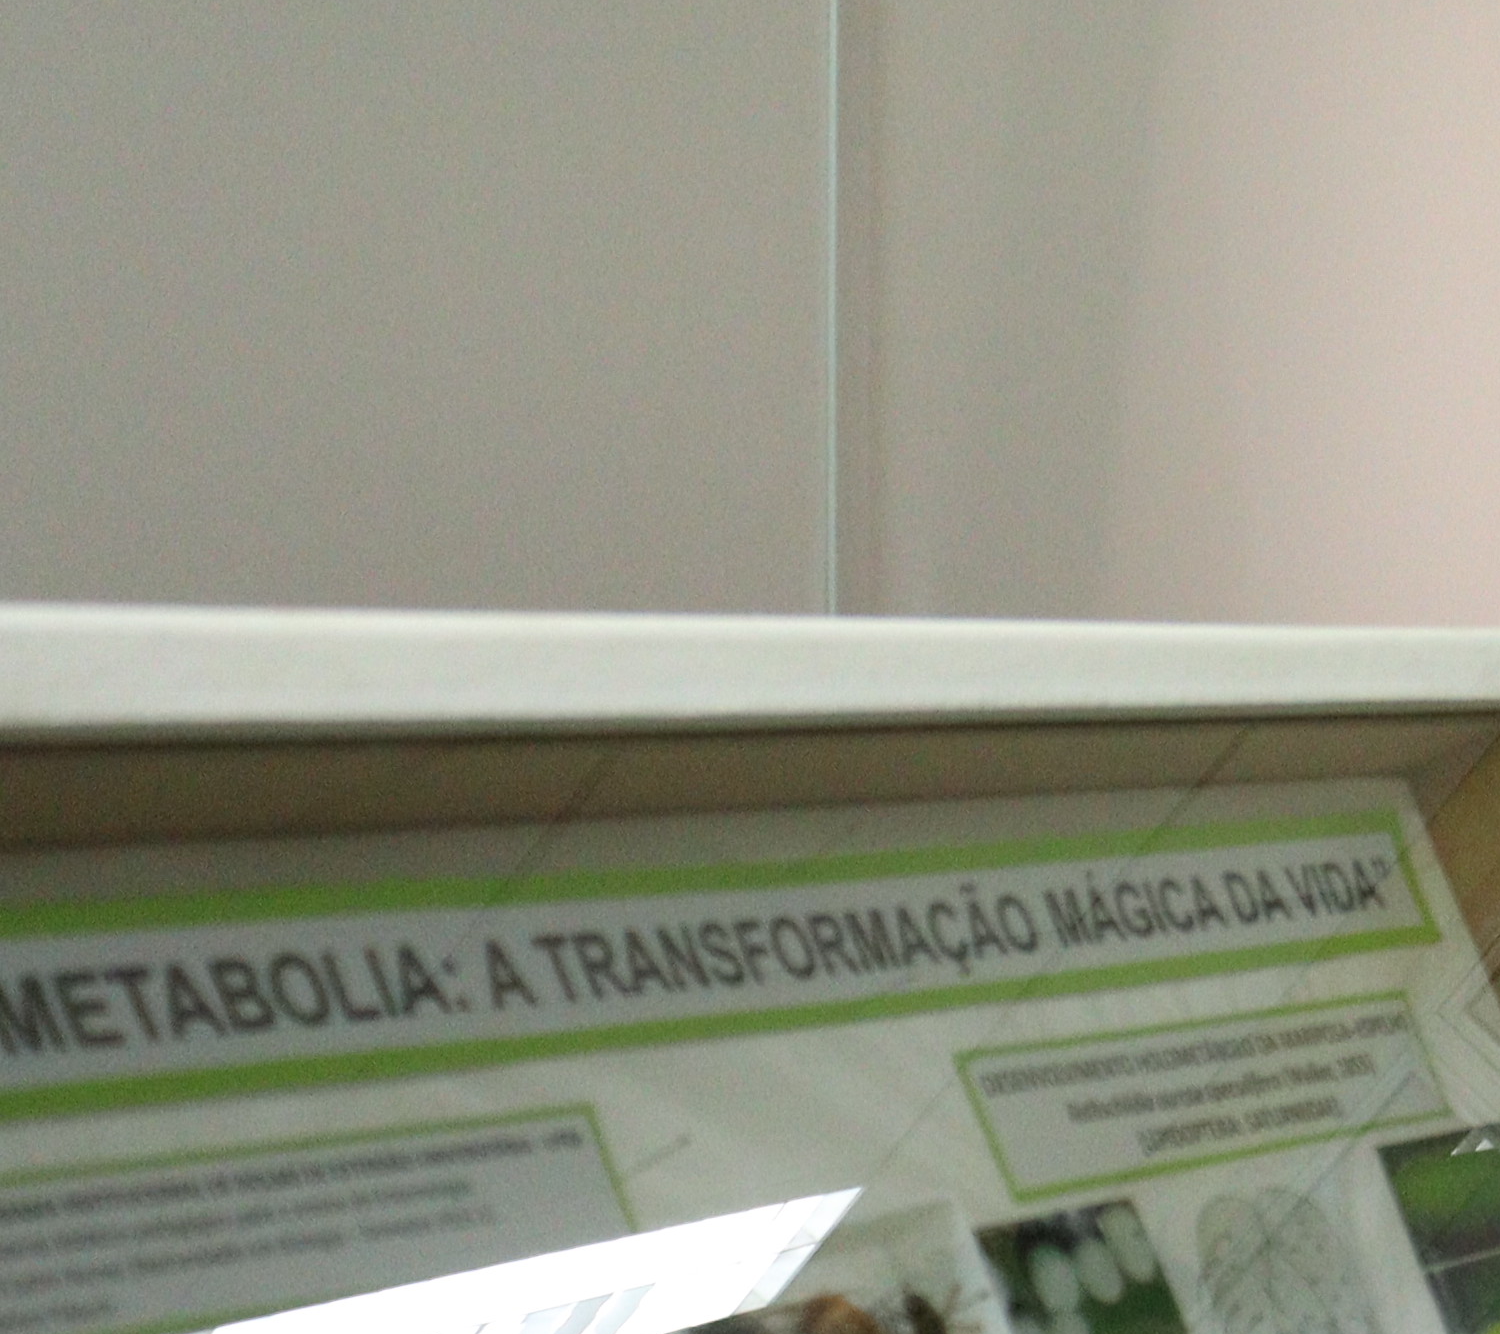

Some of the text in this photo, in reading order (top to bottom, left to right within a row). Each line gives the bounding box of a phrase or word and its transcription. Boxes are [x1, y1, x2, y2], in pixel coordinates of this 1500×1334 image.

[483, 940, 539, 1011] A
[541, 885, 1039, 1005] TRANSFORMAÇÃO
[1037, 863, 1229, 951] MÁGICA
[1220, 869, 1294, 927] DA
